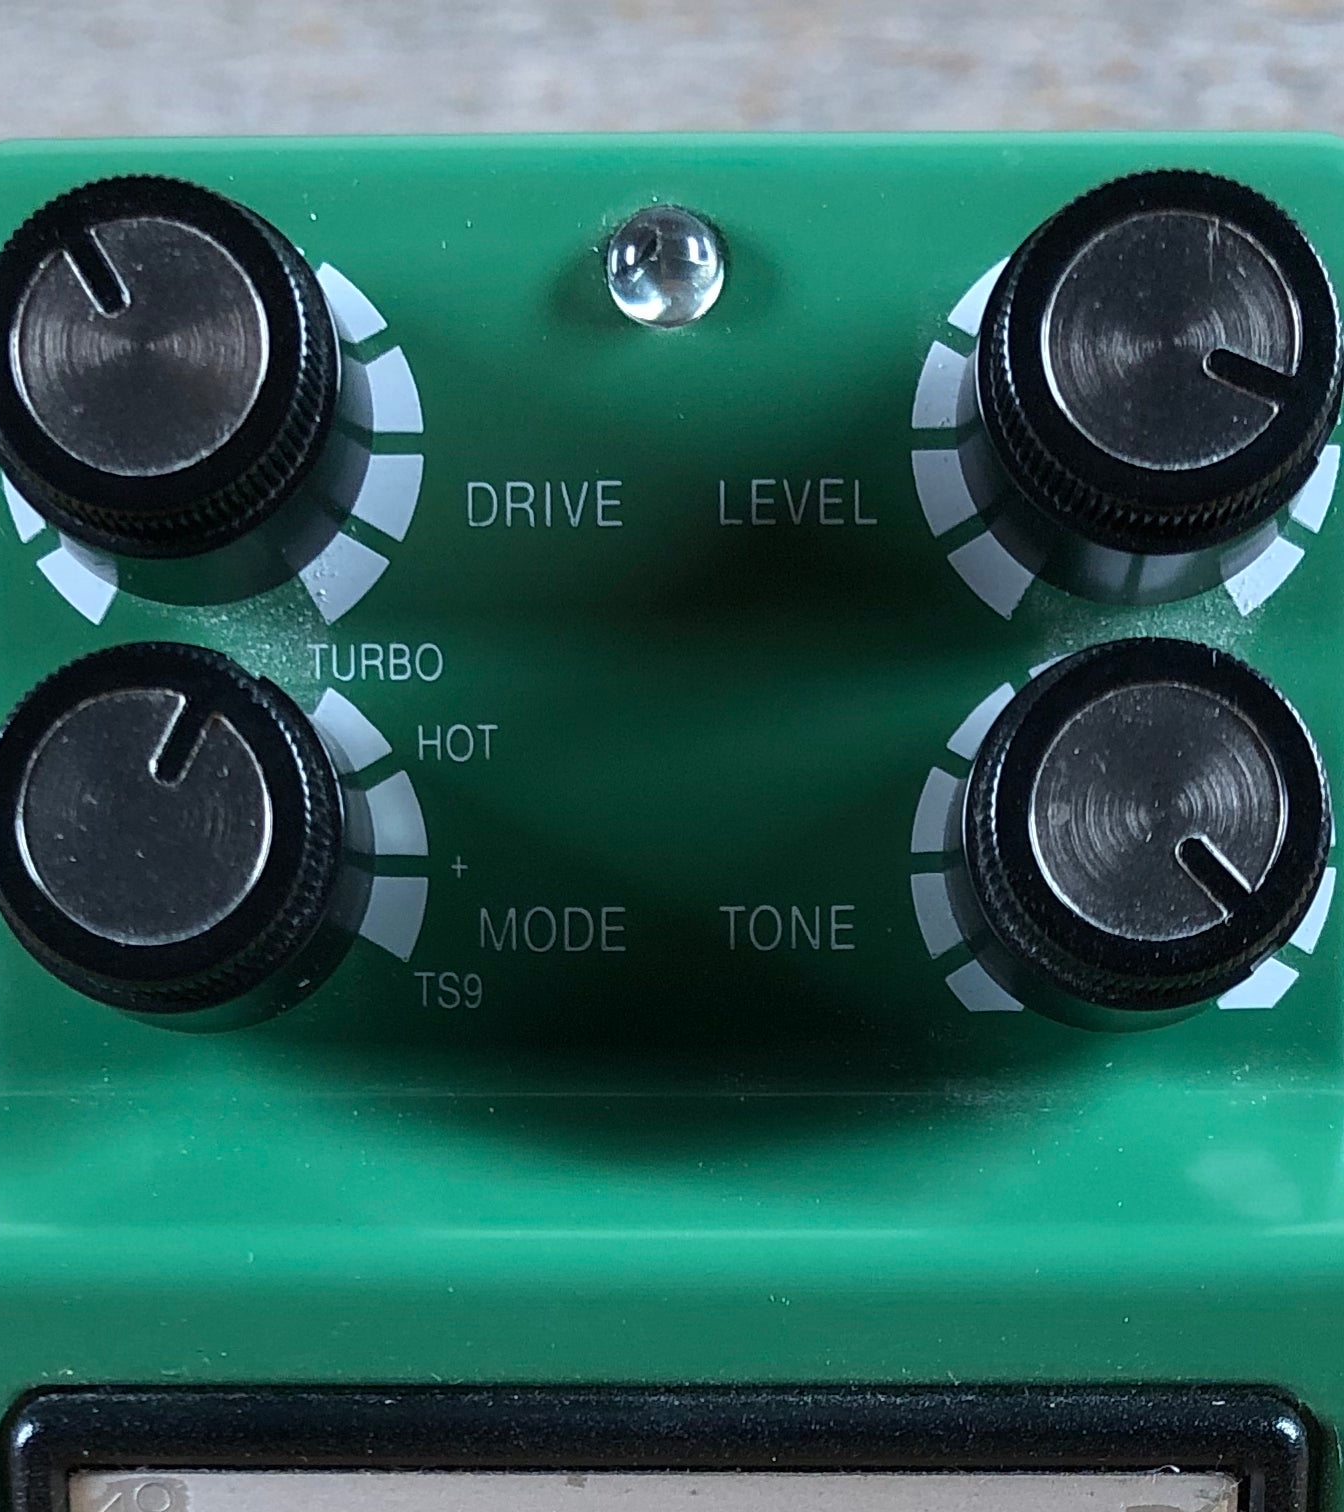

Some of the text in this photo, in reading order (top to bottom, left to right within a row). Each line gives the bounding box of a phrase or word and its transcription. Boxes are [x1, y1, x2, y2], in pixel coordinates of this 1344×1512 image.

[467, 480, 623, 528] DRIVE
[719, 479, 878, 526] LEVEL
[307, 643, 444, 683] TURBO
[417, 724, 499, 762] HOT
[479, 906, 627, 952] MODE
[719, 905, 856, 951] TONE
[414, 971, 483, 1010] TS9
